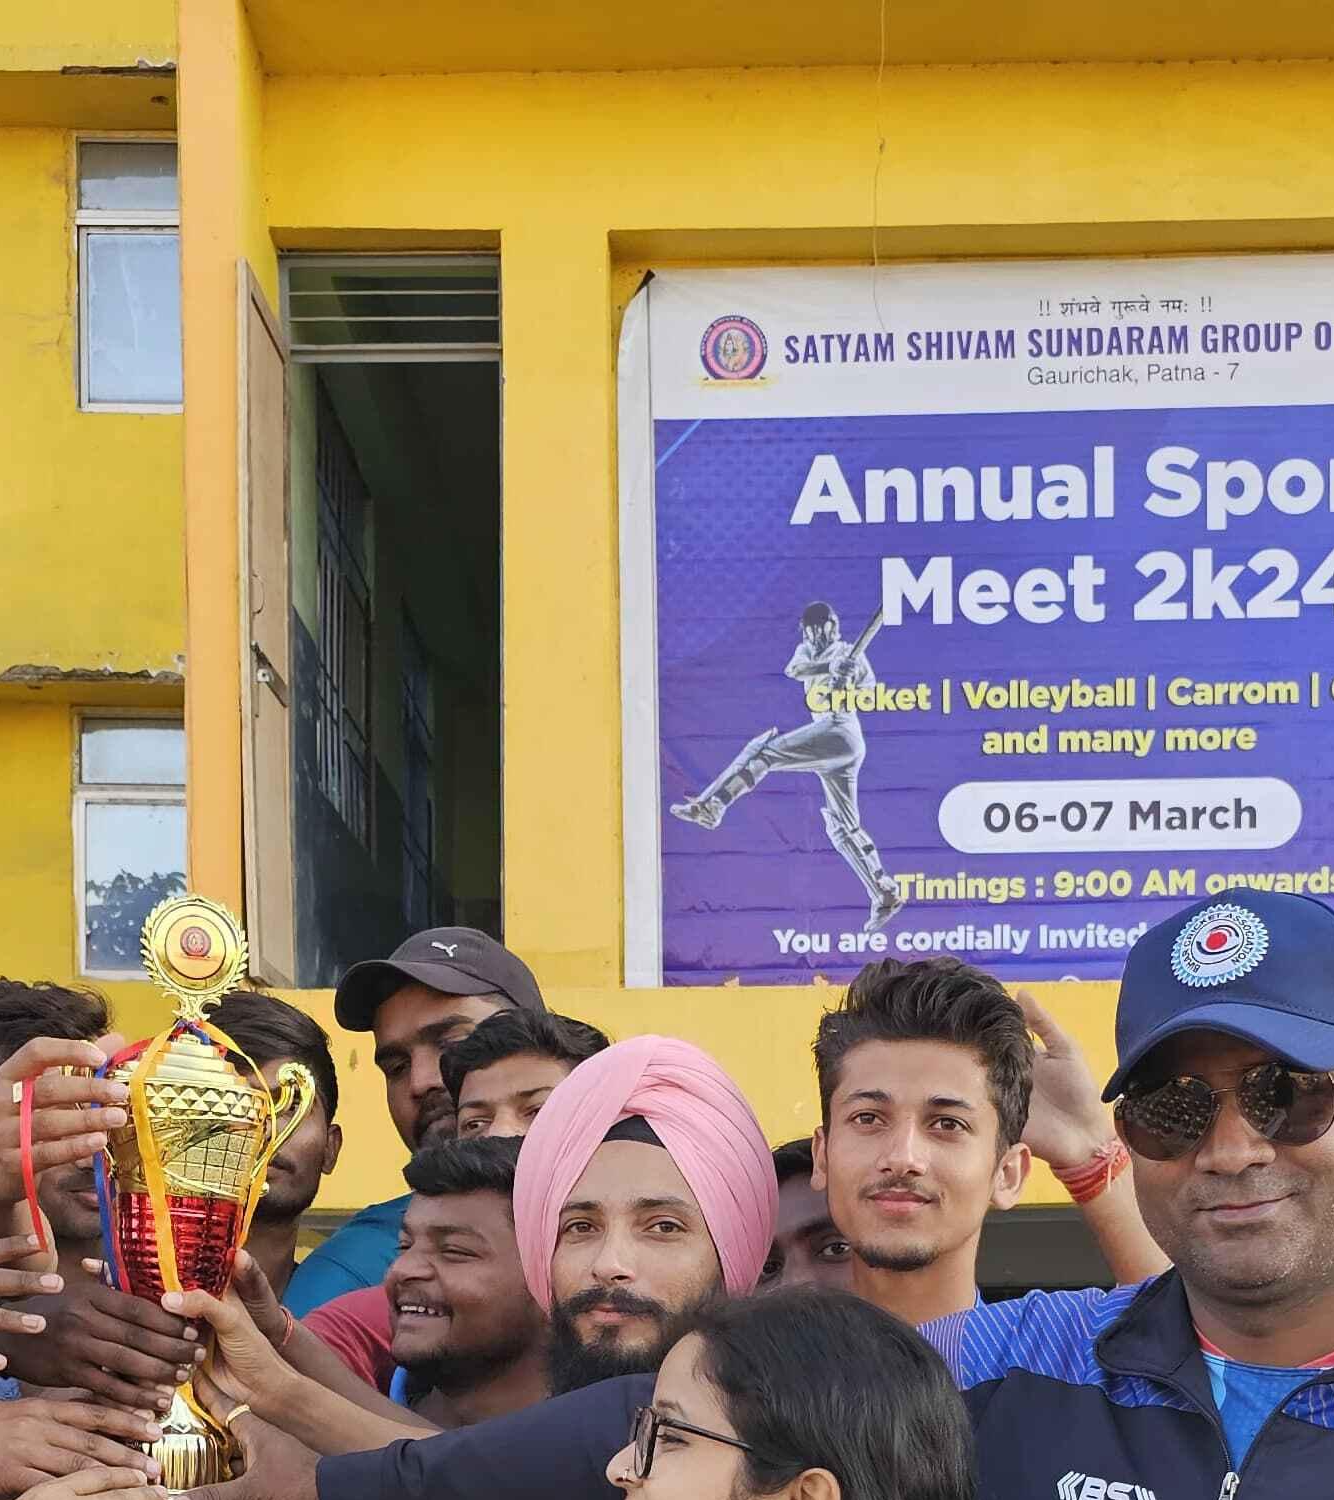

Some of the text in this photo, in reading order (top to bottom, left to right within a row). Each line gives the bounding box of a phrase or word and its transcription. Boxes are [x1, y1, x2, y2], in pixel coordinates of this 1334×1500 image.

[784, 333, 895, 364] SATYAM
[907, 329, 1016, 361] SHIVAM
[1027, 324, 1189, 358] SUNDARAM
[1201, 322, 1303, 353] GROUP
[1027, 365, 1139, 386] Gaurichak,
[1147, 363, 1205, 382] Patna
[1227, 363, 1240, 381] 7
[790, 445, 1114, 525] Annual
[882, 555, 1106, 626] Meet
[806, 682, 932, 713] Cricket
[962, 678, 1136, 713] Volleyball
[1167, 677, 1300, 706] Carrom
[982, 725, 1258, 757] and many more
[983, 797, 1258, 833] 06-07 March
[893, 872, 1026, 903] Timings
[1053, 870, 1132, 898] 9:00
[1142, 869, 1197, 896] AM
[773, 922, 1148, 954] You are cordially Invited
[1183, 913, 1223, 948] CRICKET
[1226, 913, 1255, 965] ASSOCIATION
